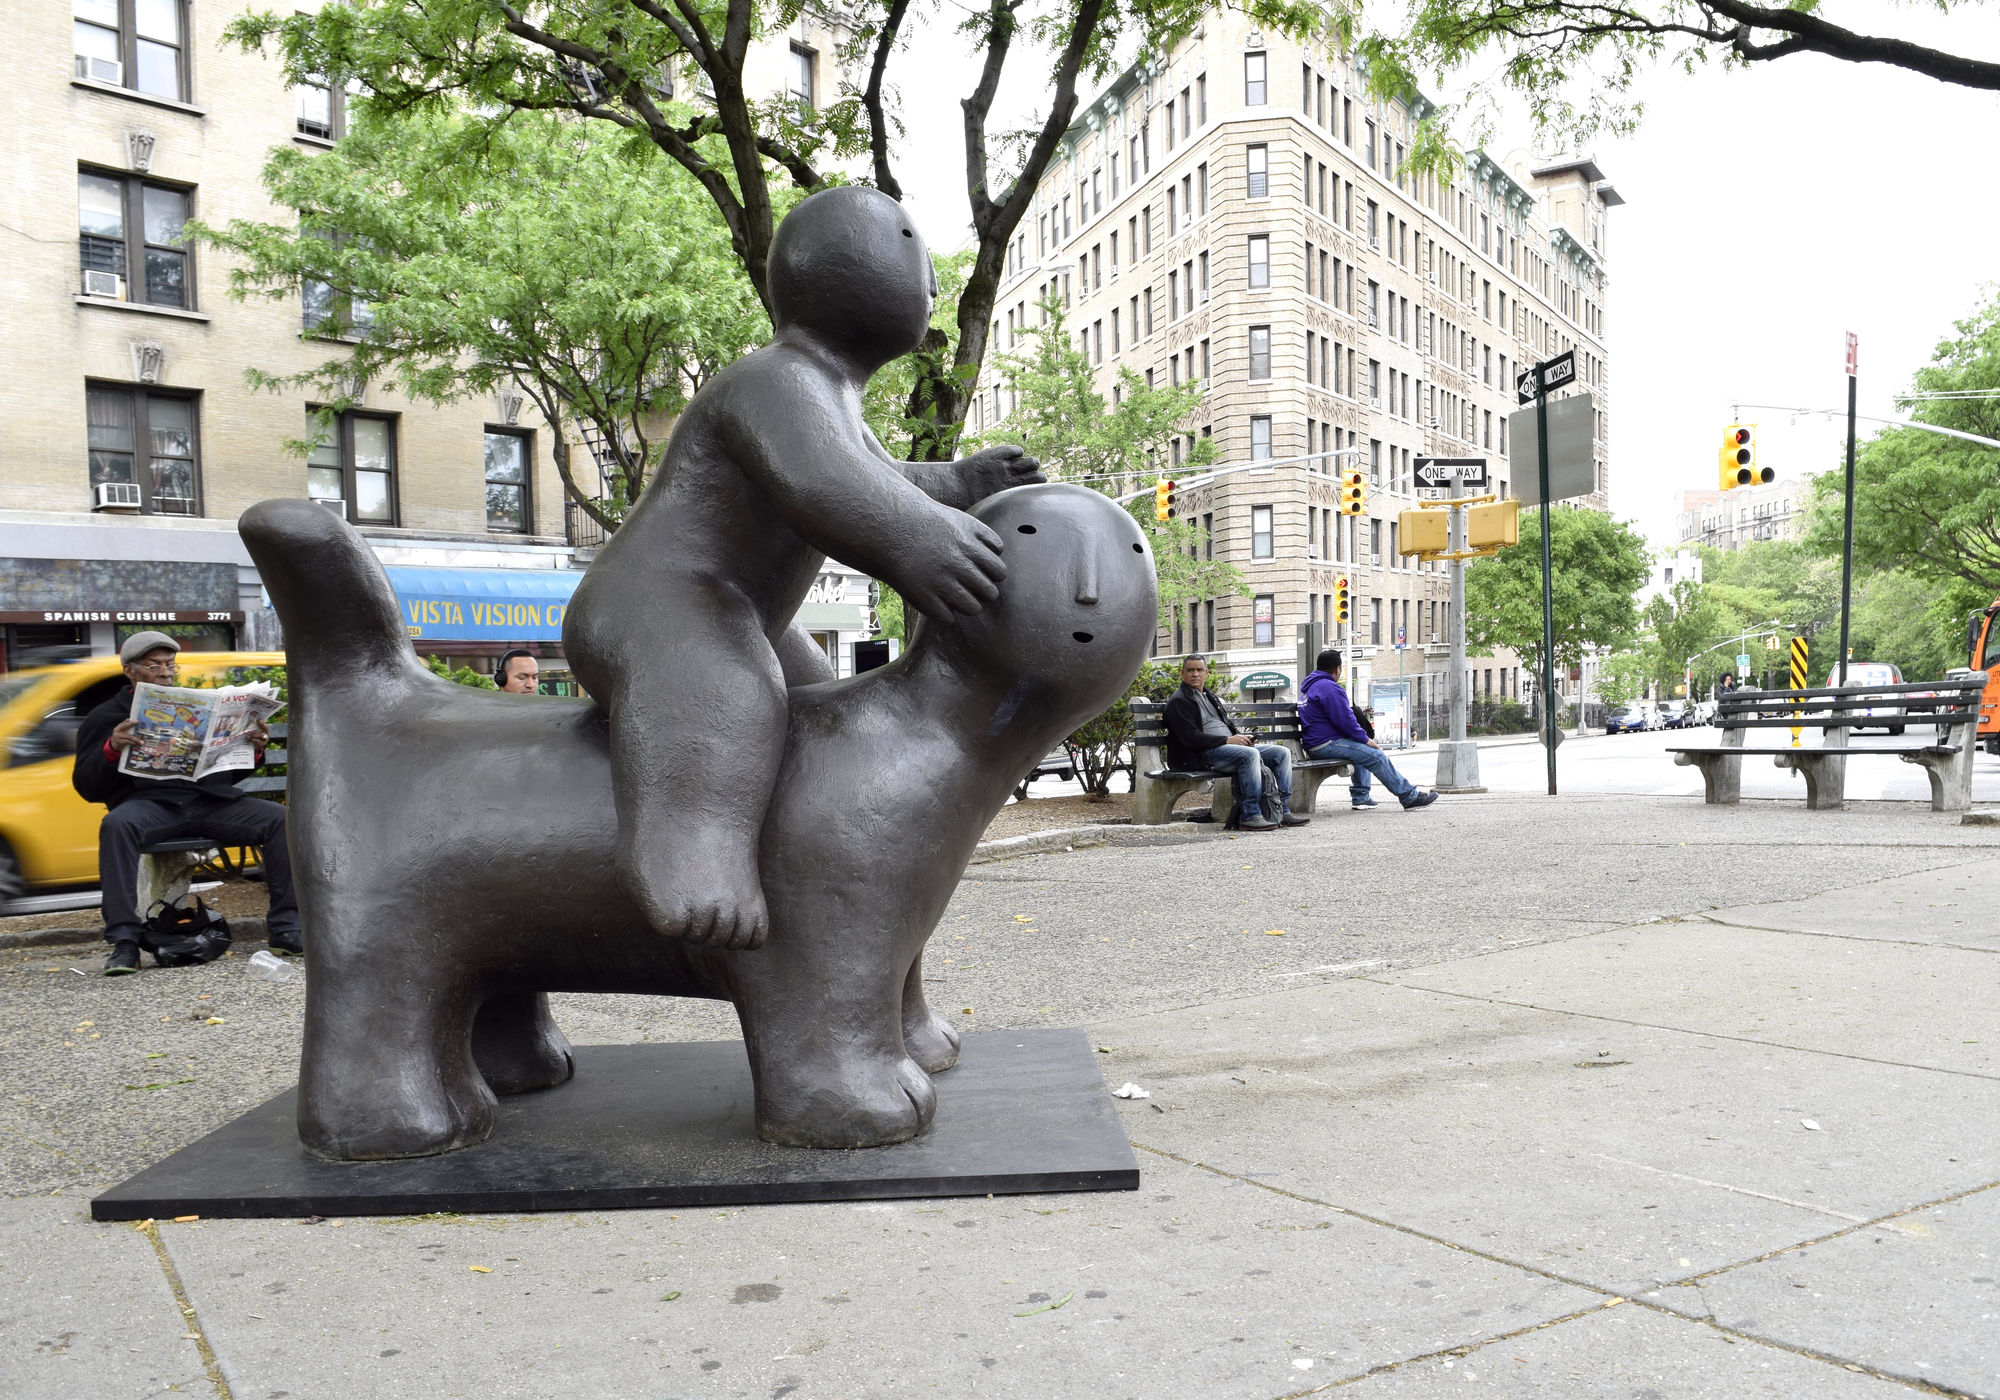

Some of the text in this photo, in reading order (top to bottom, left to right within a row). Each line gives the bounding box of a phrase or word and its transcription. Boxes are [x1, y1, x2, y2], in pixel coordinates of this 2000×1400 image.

[1523, 377, 1537, 394] ON
[1550, 361, 1570, 381] WAY
[1424, 467, 1478, 479] ONE WAY
[803, 575, 852, 604] arket
[43, 612, 176, 622] SPANISH CUISINE
[207, 612, 231, 621] 3771
[408, 600, 464, 625] VISTA
[470, 603, 541, 626] VISION
[221, 696, 230, 704] LA
